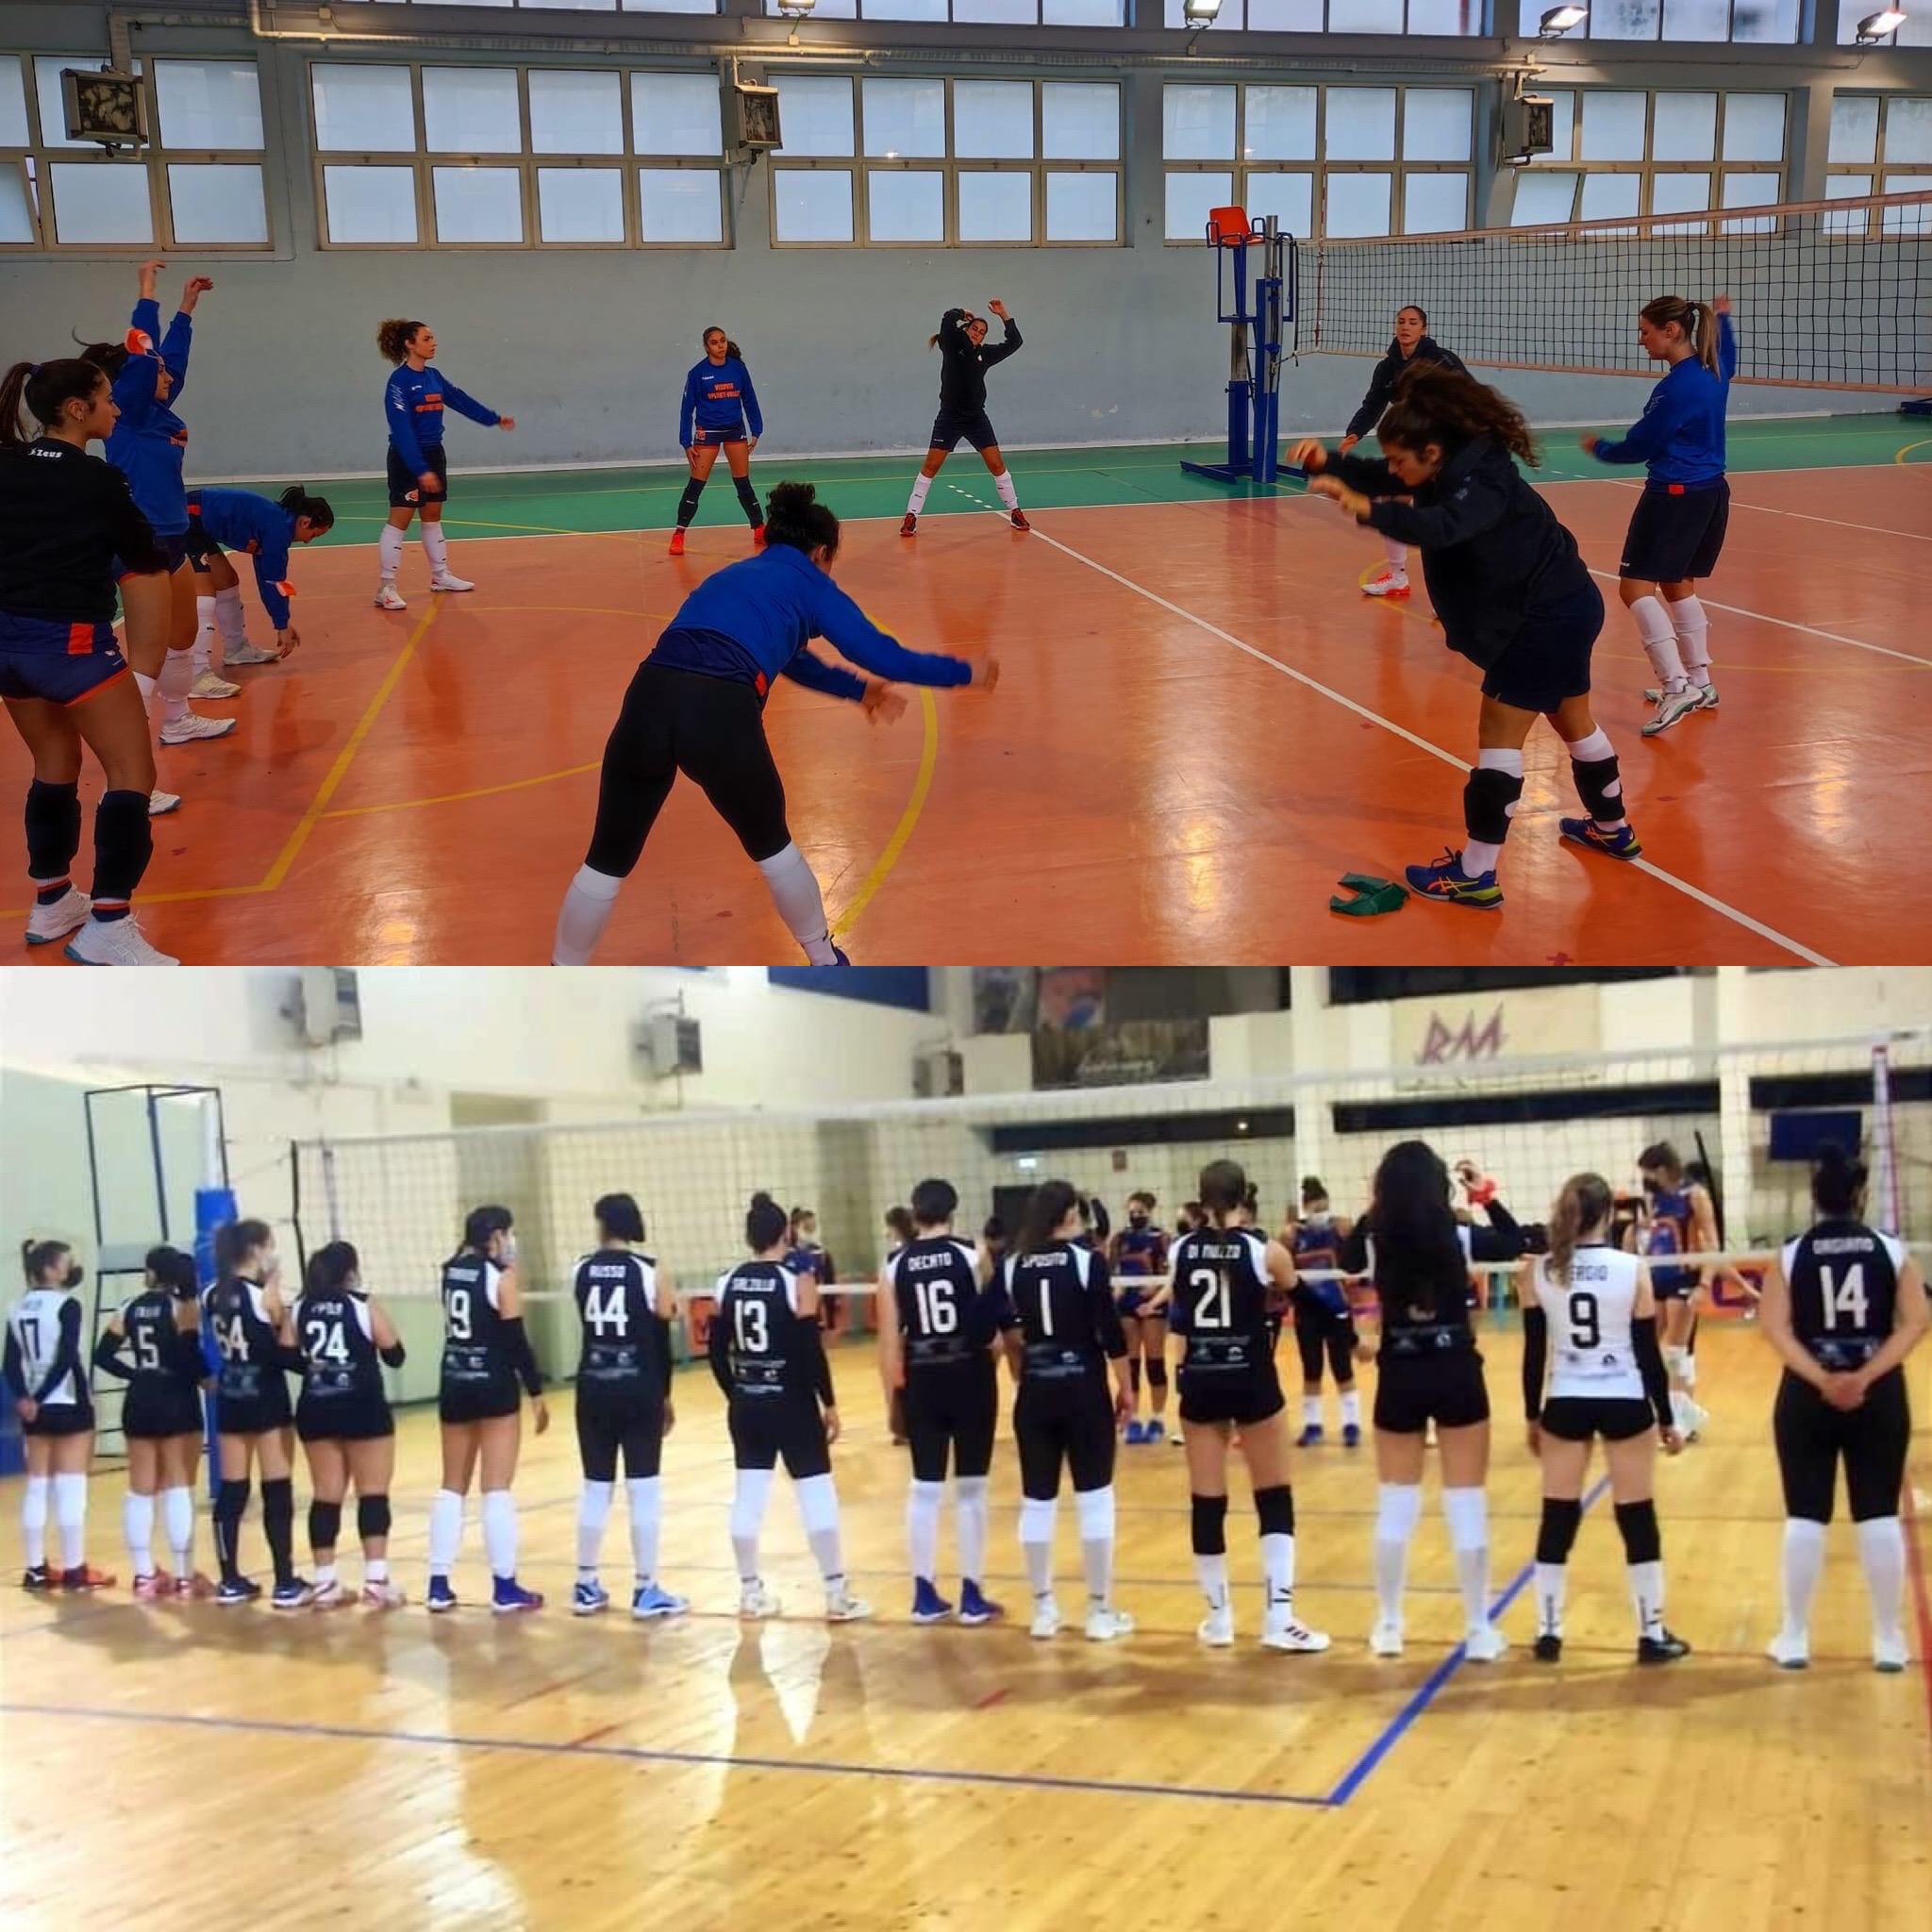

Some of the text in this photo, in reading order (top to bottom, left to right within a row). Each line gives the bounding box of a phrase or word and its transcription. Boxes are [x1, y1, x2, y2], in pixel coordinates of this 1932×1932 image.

[37, 449, 63, 458] Zeus
[585, 1285, 629, 1337] 44
[915, 1279, 958, 1335] 16
[1040, 1278, 1054, 1336] 1
[1190, 1268, 1231, 1328] 21
[1569, 1291, 1601, 1350] 9
[1819, 1263, 1869, 1330] 14
[137, 1325, 159, 1369] 5
[306, 1320, 351, 1365] 24
[734, 1299, 769, 1353] 13
